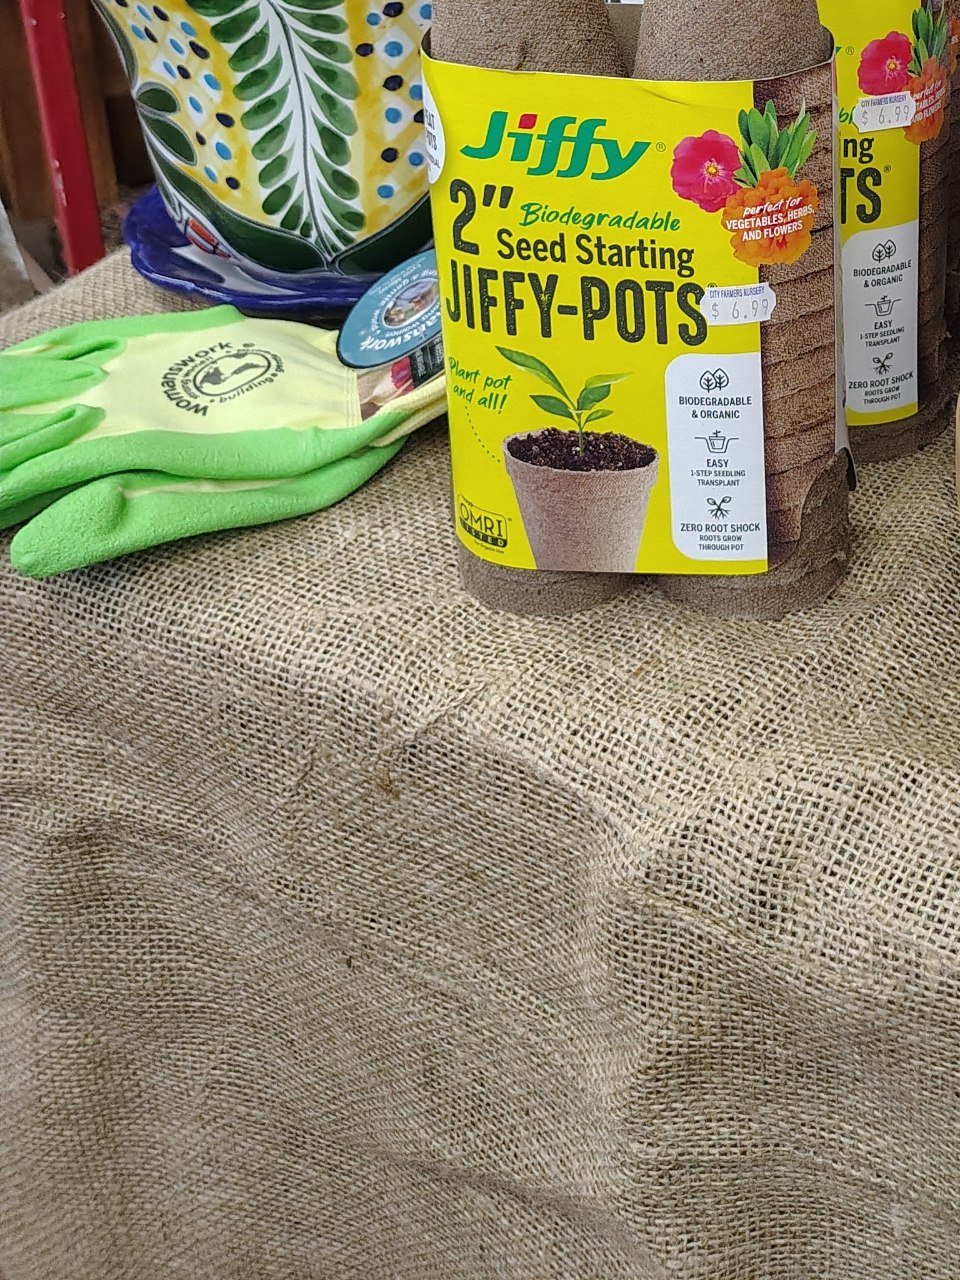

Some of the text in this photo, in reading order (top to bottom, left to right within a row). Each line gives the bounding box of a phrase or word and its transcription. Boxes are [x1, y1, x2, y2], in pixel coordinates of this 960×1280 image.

[861, 94, 907, 108] CITY FARMERS NURSERY
[878, 104, 911, 125] 6.99
[459, 110, 652, 180] Jiffy
[742, 196, 803, 218] perfect for
[519, 202, 681, 231] Biodegradable
[725, 204, 815, 230] VEGETABLES, HERBS,
[742, 220, 803, 241] AND FLOWERS
[496, 227, 695, 278] Seed Starting
[853, 259, 912, 277] BIODEGRADABLE
[863, 273, 903, 288] & ORGANIC
[709, 285, 766, 299] CITY FARMERS NURSERY
[445, 259, 708, 346] JIFFY-POTS
[731, 298, 771, 321] 6.99
[360, 312, 441, 351] answork
[860, 326, 905, 340] 1-STEP SEEDLING
[873, 320, 893, 330] EASY
[865, 335, 900, 348] TRANSPLANT
[160, 342, 234, 417] womanswork
[448, 356, 513, 391] Plant pot
[848, 370, 914, 389] ZERO ROOT SHOCK
[219, 376, 275, 403] building
[863, 392, 902, 405] THROUGH POT
[864, 385, 900, 397] ROOTS GROW
[453, 384, 508, 415] and all!
[678, 395, 752, 407] BIODEGRADABLE
[691, 409, 741, 419] & ORGANIC
[706, 458, 729, 468] EASY
[690, 469, 713, 477] 1-STEP
[697, 479, 741, 487] TRANSPLANT
[460, 502, 503, 537] OMRI
[680, 522, 761, 533] ZERO ROOT SHOCK
[698, 543, 745, 551] THROUGH POT
[699, 534, 743, 542] ROOTS GROW
